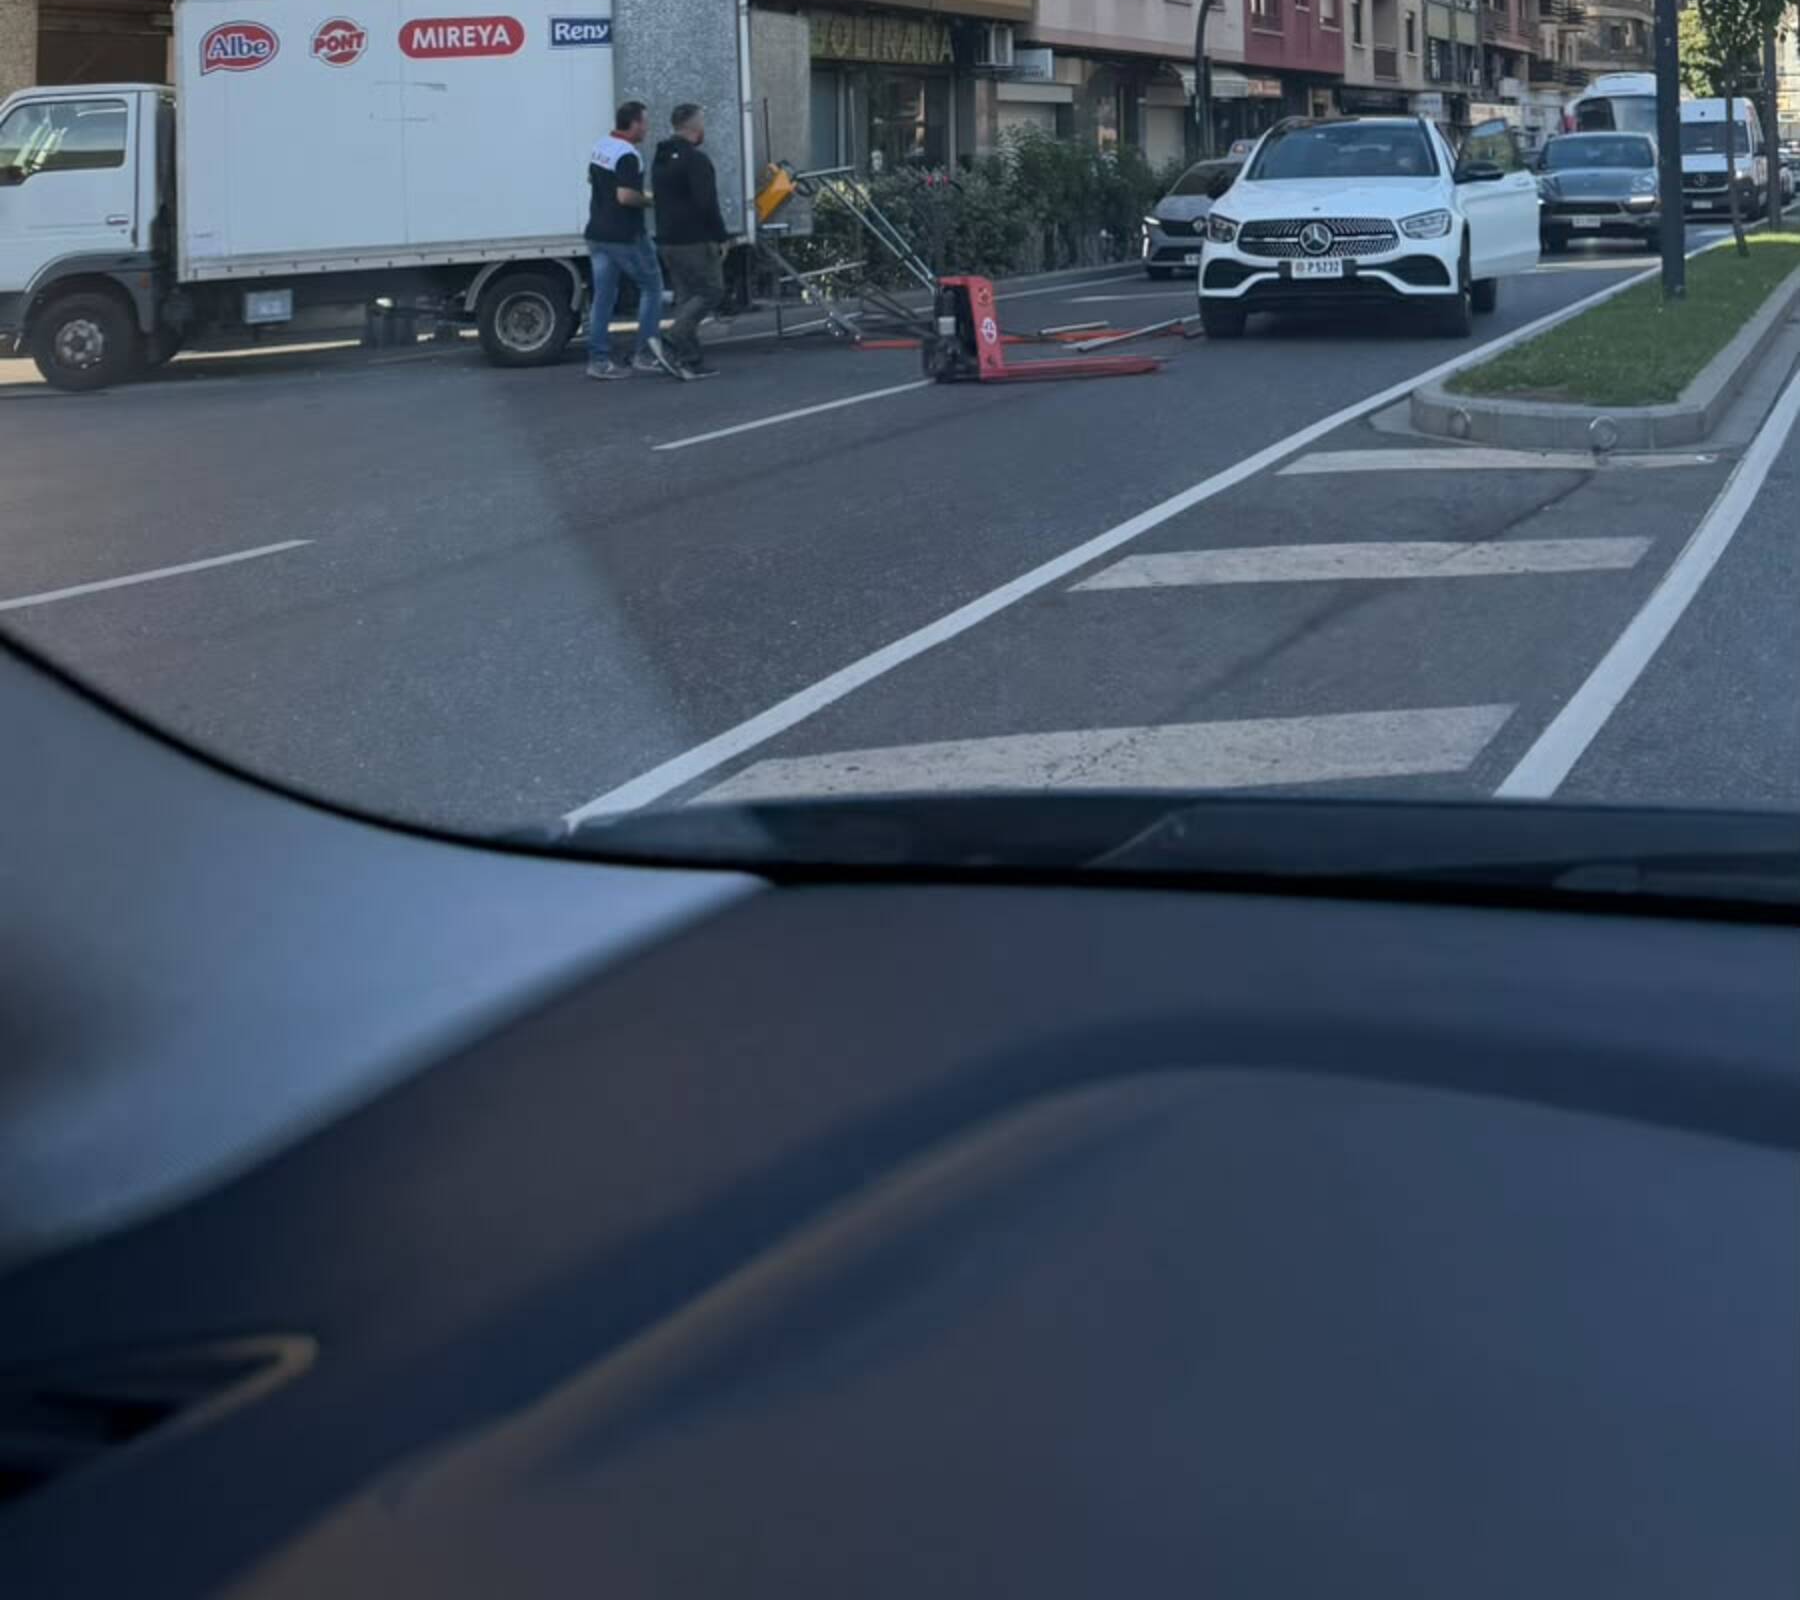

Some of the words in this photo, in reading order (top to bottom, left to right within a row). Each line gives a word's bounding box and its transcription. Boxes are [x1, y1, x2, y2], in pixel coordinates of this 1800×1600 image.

[210, 35, 267, 57] Albe
[313, 31, 365, 54] PONT
[412, 24, 511, 50] MIREYA
